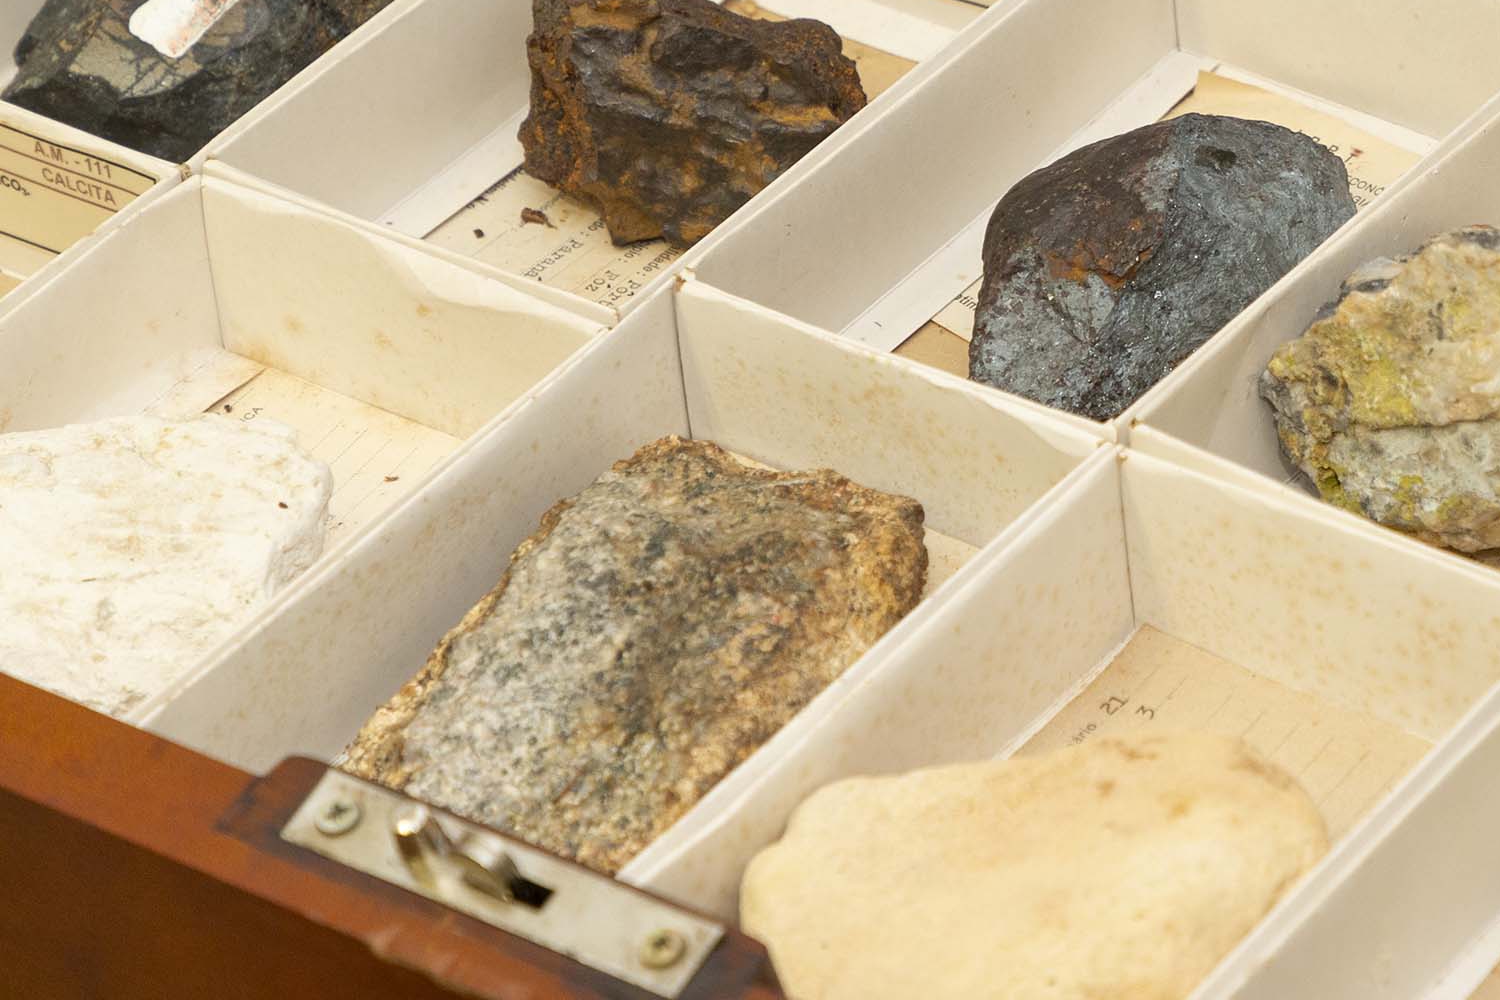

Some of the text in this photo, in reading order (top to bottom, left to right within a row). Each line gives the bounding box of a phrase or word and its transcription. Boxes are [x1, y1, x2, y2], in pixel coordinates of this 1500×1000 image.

[34, 141, 70, 165] A.M.
[84, 158, 112, 178] 111
[42, 168, 117, 205] CALCITA
[1135, 705, 1155, 720] 3
